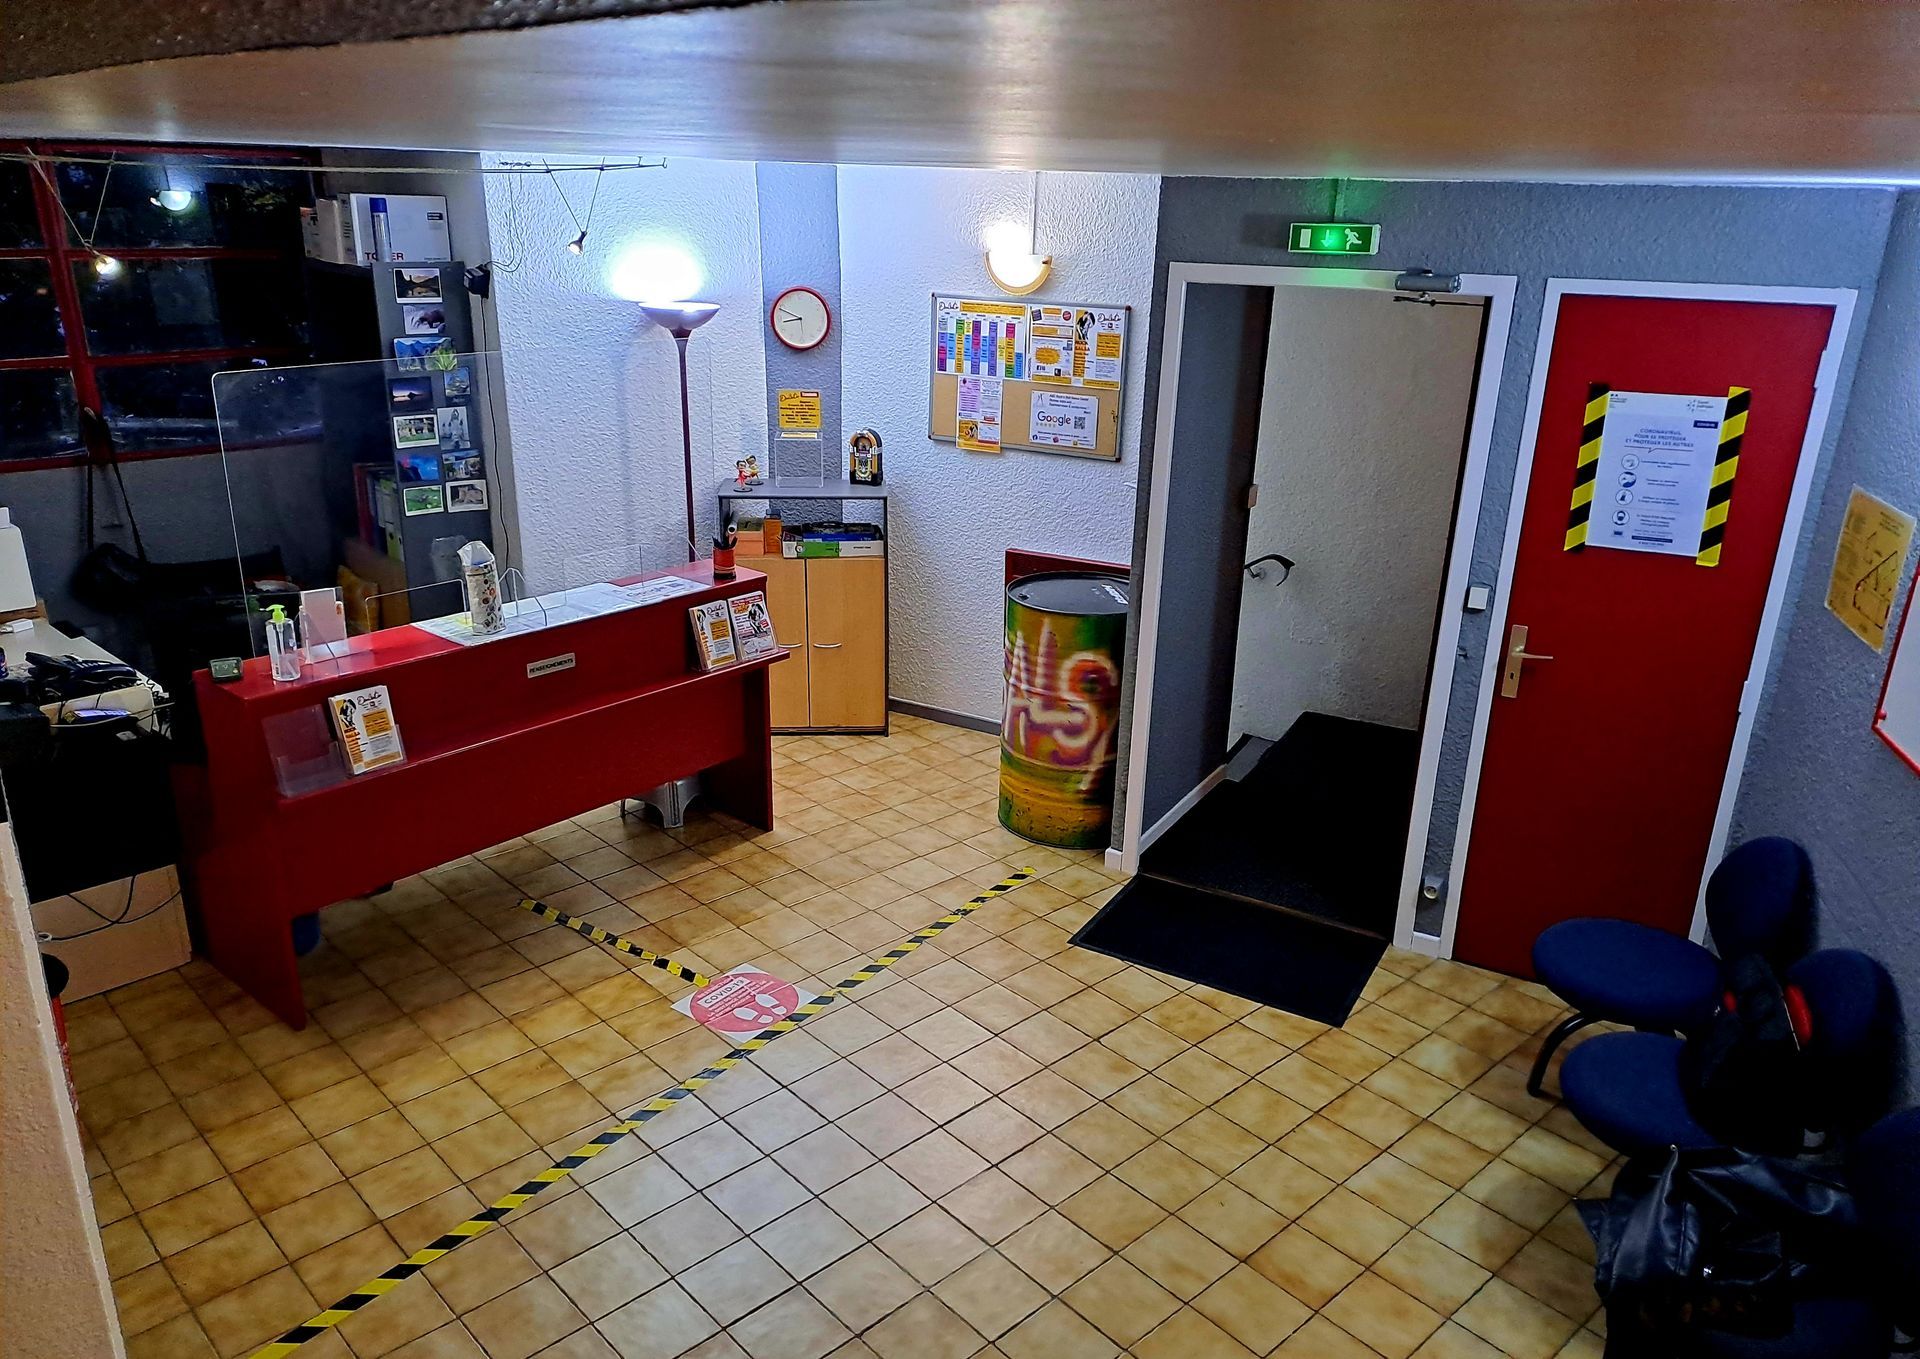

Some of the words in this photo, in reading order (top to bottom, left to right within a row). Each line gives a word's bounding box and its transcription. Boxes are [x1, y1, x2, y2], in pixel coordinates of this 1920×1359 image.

[365, 252, 404, 261] TOER
[1037, 410, 1071, 426] Google
[702, 979, 745, 1004] COVID-19
